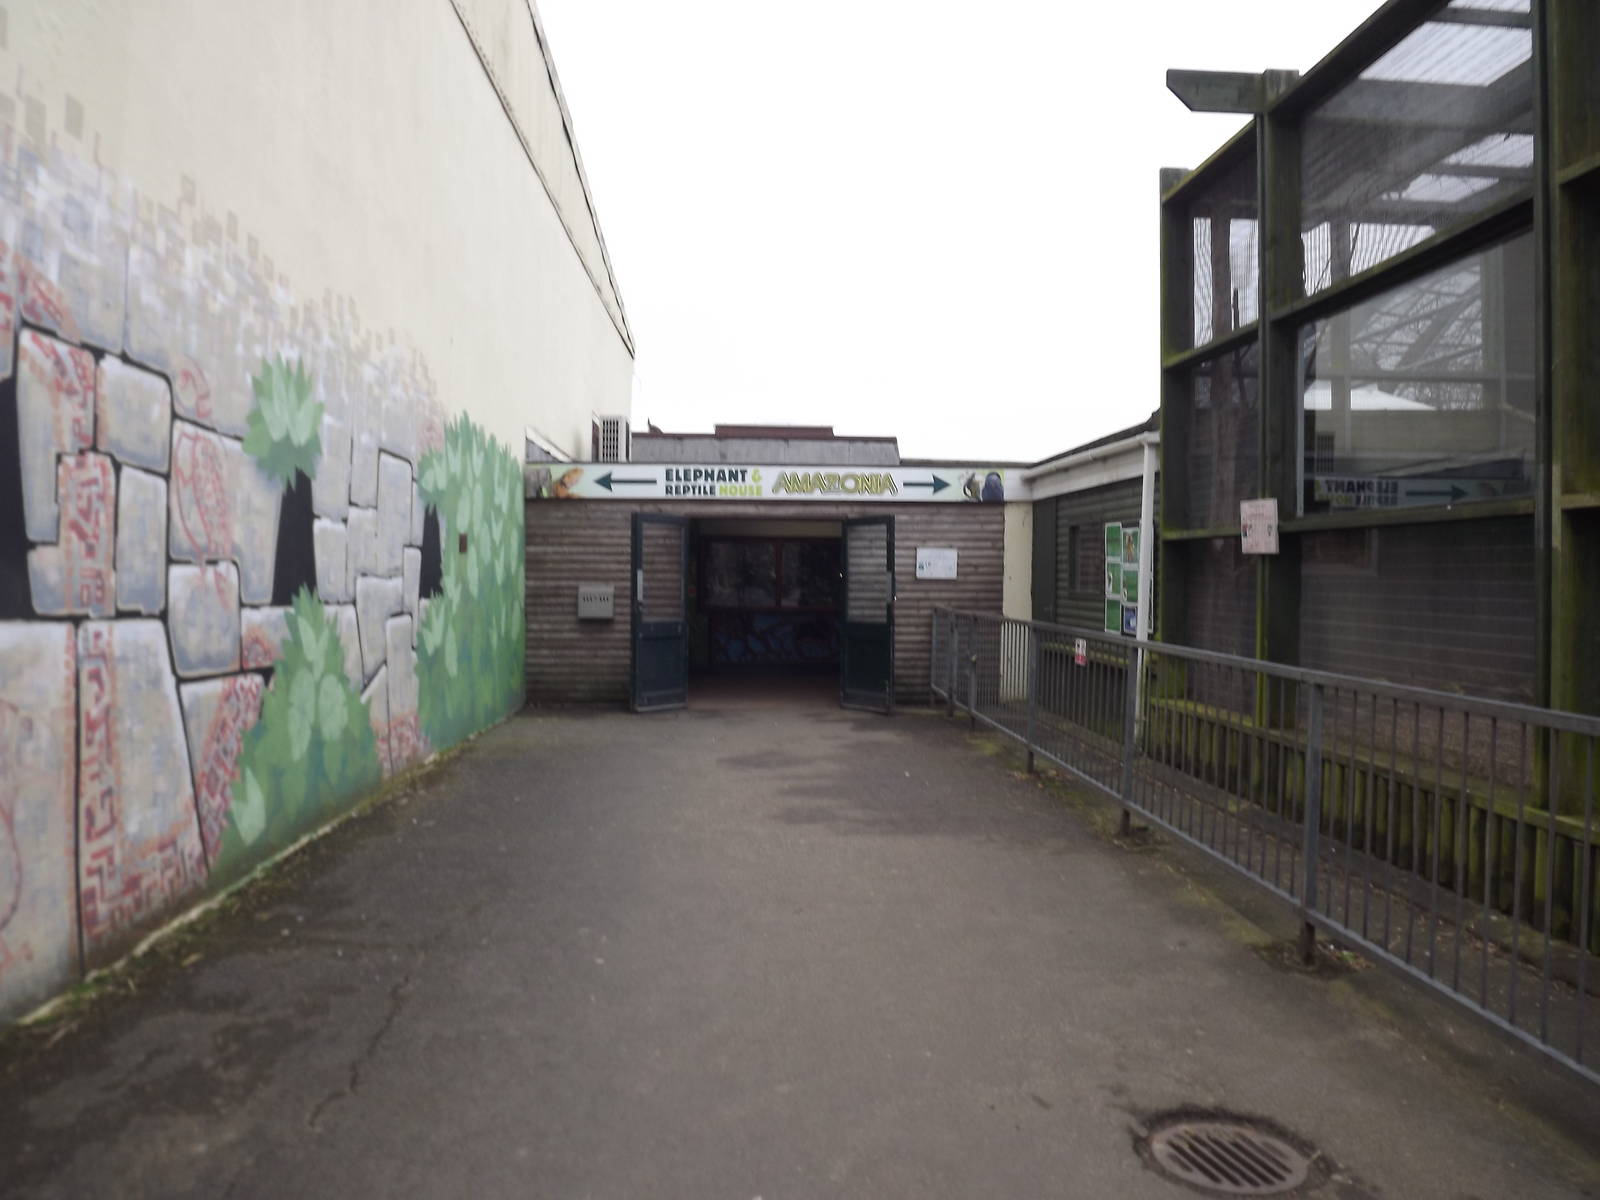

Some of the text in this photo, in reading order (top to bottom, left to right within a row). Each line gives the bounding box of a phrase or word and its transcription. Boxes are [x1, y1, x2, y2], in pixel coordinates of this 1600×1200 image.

[665, 469, 747, 482] ELEPHANT
[665, 485, 762, 496] REPTILE HOUSE
[771, 472, 898, 496] AMAZONIA
